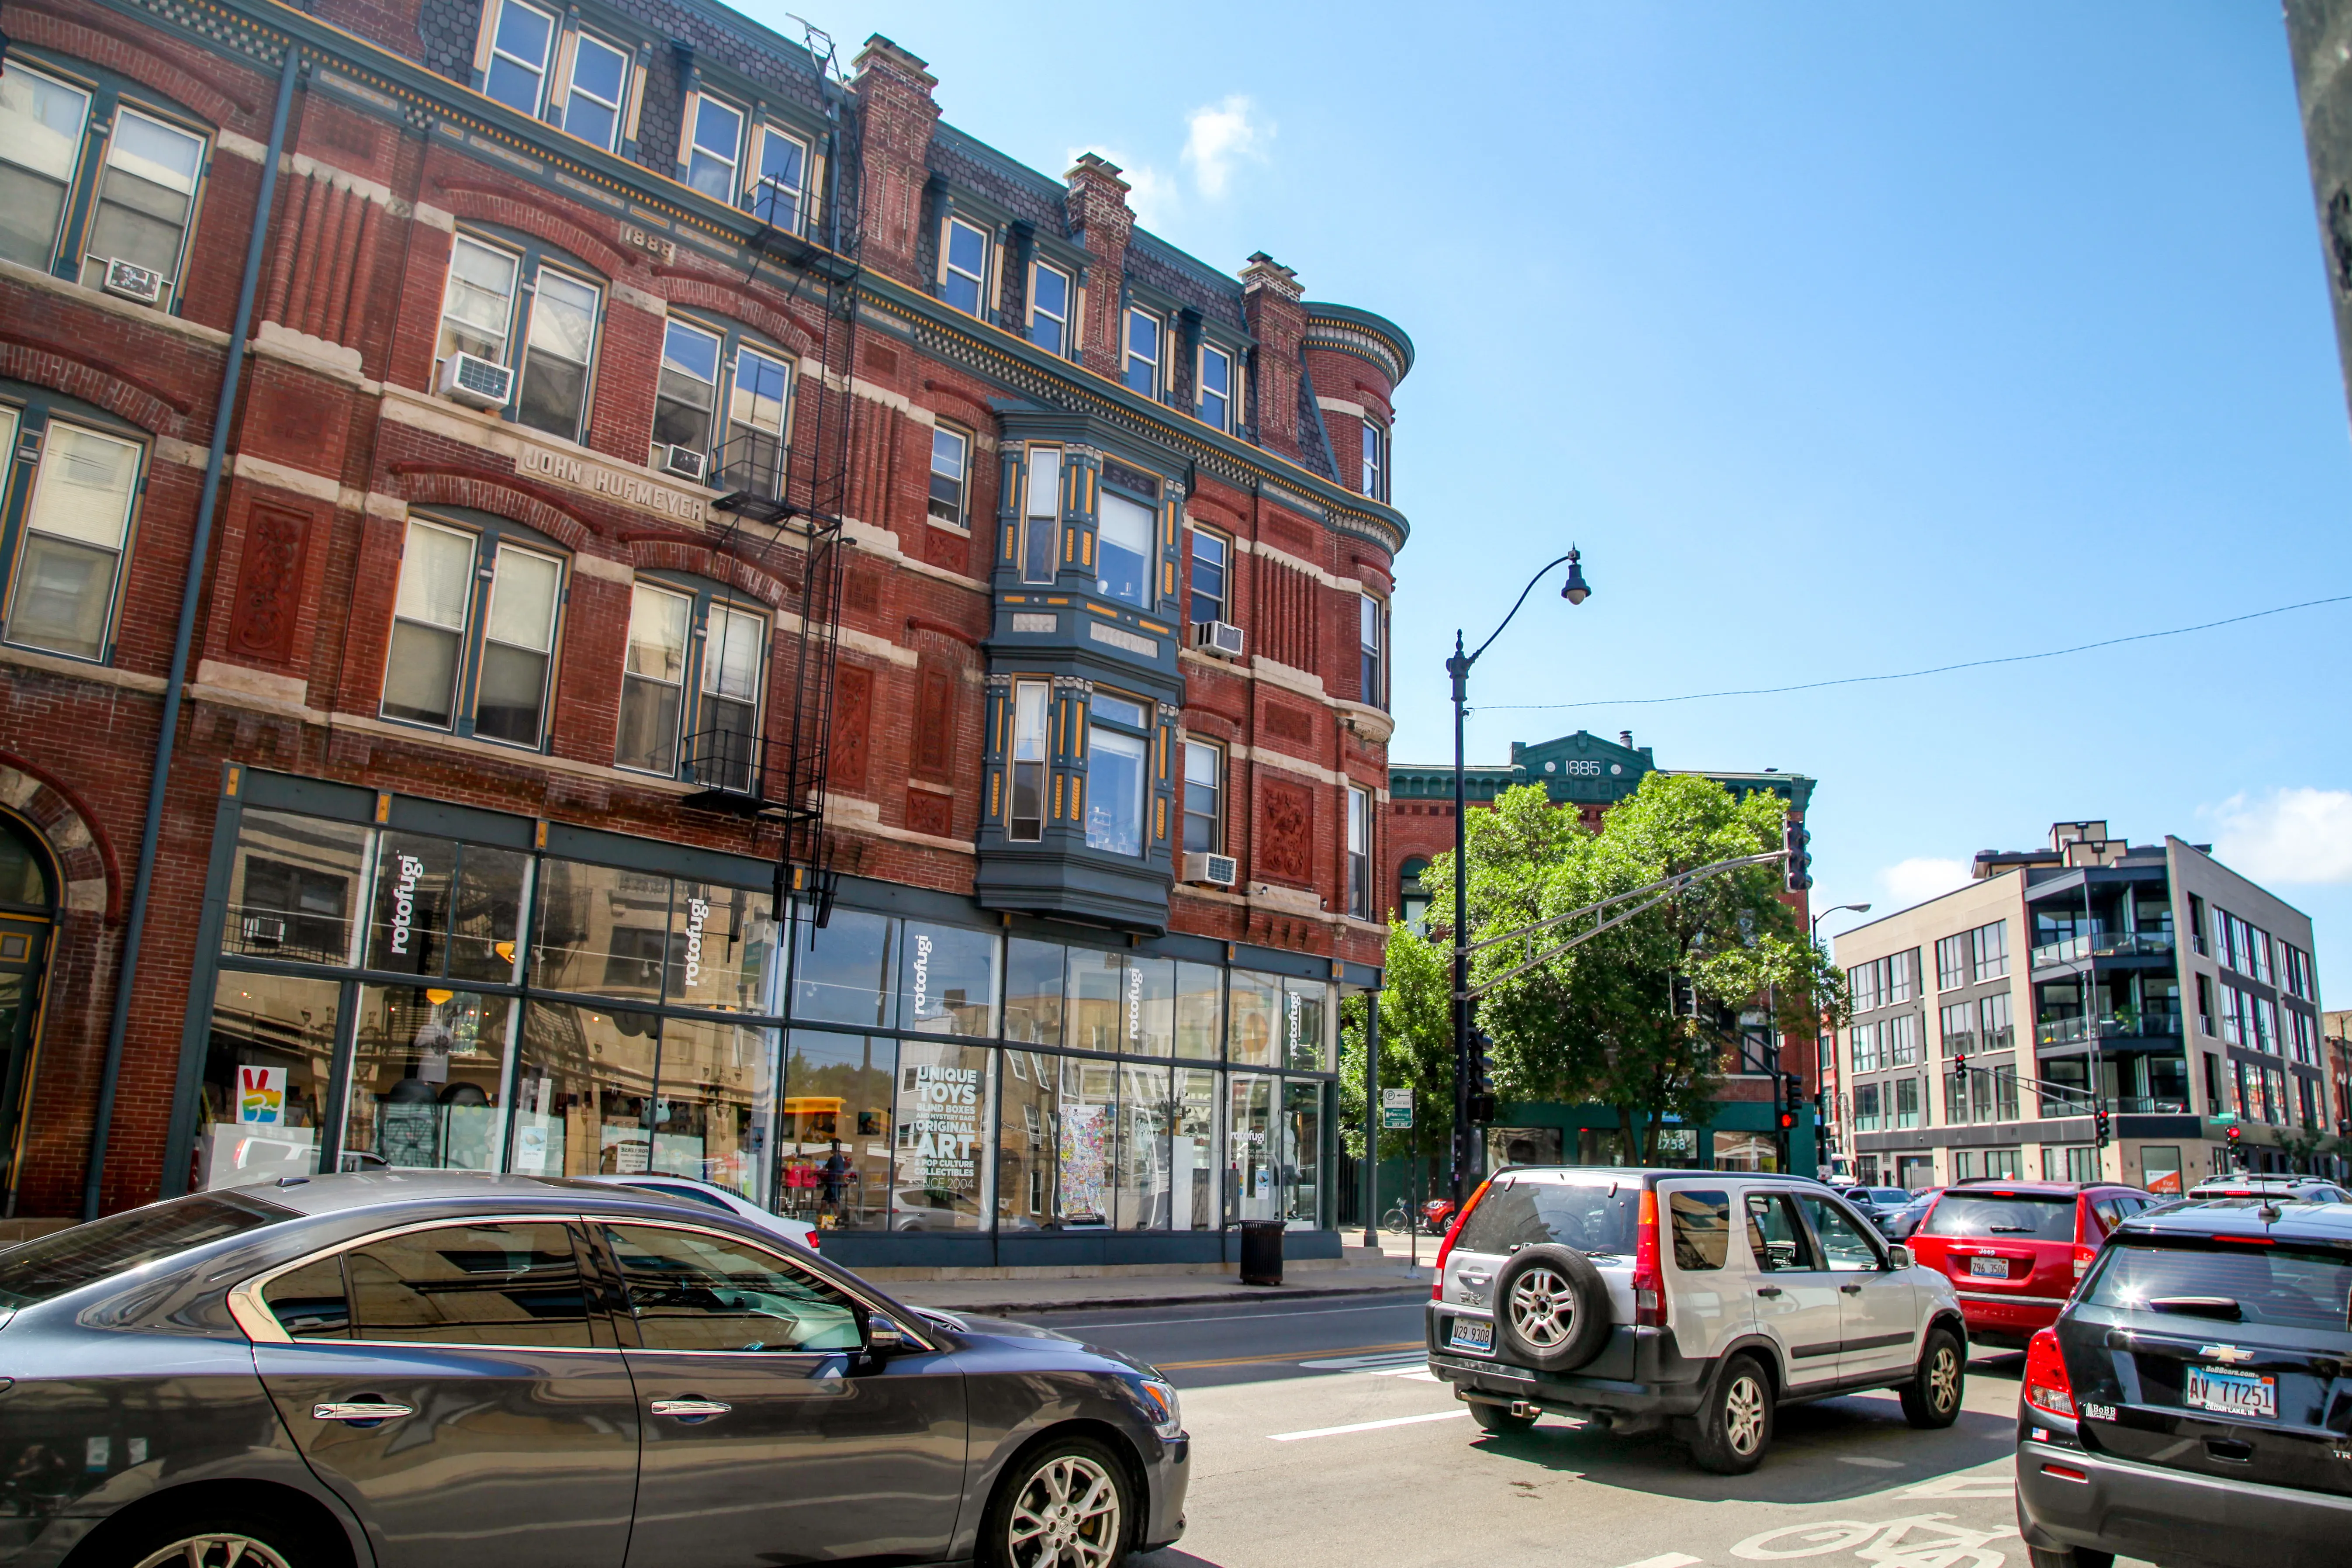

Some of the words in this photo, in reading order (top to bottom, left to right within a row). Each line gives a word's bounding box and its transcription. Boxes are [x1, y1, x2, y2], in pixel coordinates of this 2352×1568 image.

[526, 450, 582, 483] JOHN
[595, 470, 706, 522] HUFMEYER
[1566, 760, 1600, 775] 1885
[391, 855, 424, 954] rotofugi
[684, 898, 709, 986] rotofugi
[913, 935, 932, 1015] rotofugi
[1128, 968, 1143, 1039] rotofugi
[1288, 991, 1301, 1056] rotofugi
[918, 1066, 977, 1083] UNIQUE
[918, 1081, 976, 1105] TOYS
[917, 1102, 944, 1113] BLIND
[945, 1104, 975, 1115] BOXES
[916, 1119, 975, 1133] ORIGINAL
[1230, 1130, 1265, 1144] rotofugi
[914, 1132, 975, 1160] ART
[914, 1167, 974, 1177] COLLECTIBLES
[939, 1160, 974, 1168] CULTURE
[913, 1178, 944, 1188] SINCE
[947, 1178, 974, 1189] 2004
[1973, 1263, 1985, 1273] Z96
[1990, 1264, 2006, 1274] 3506
[1454, 1325, 1468, 1339] V29
[1471, 1328, 1490, 1343] 9308
[2206, 1365, 2255, 1378] BoBBcars.com
[2190, 1377, 2209, 1400] AV
[2221, 1380, 2272, 1408] 77251
[2093, 1404, 2116, 1415] BoBB
[2205, 1404, 2227, 1412] CEDAR
